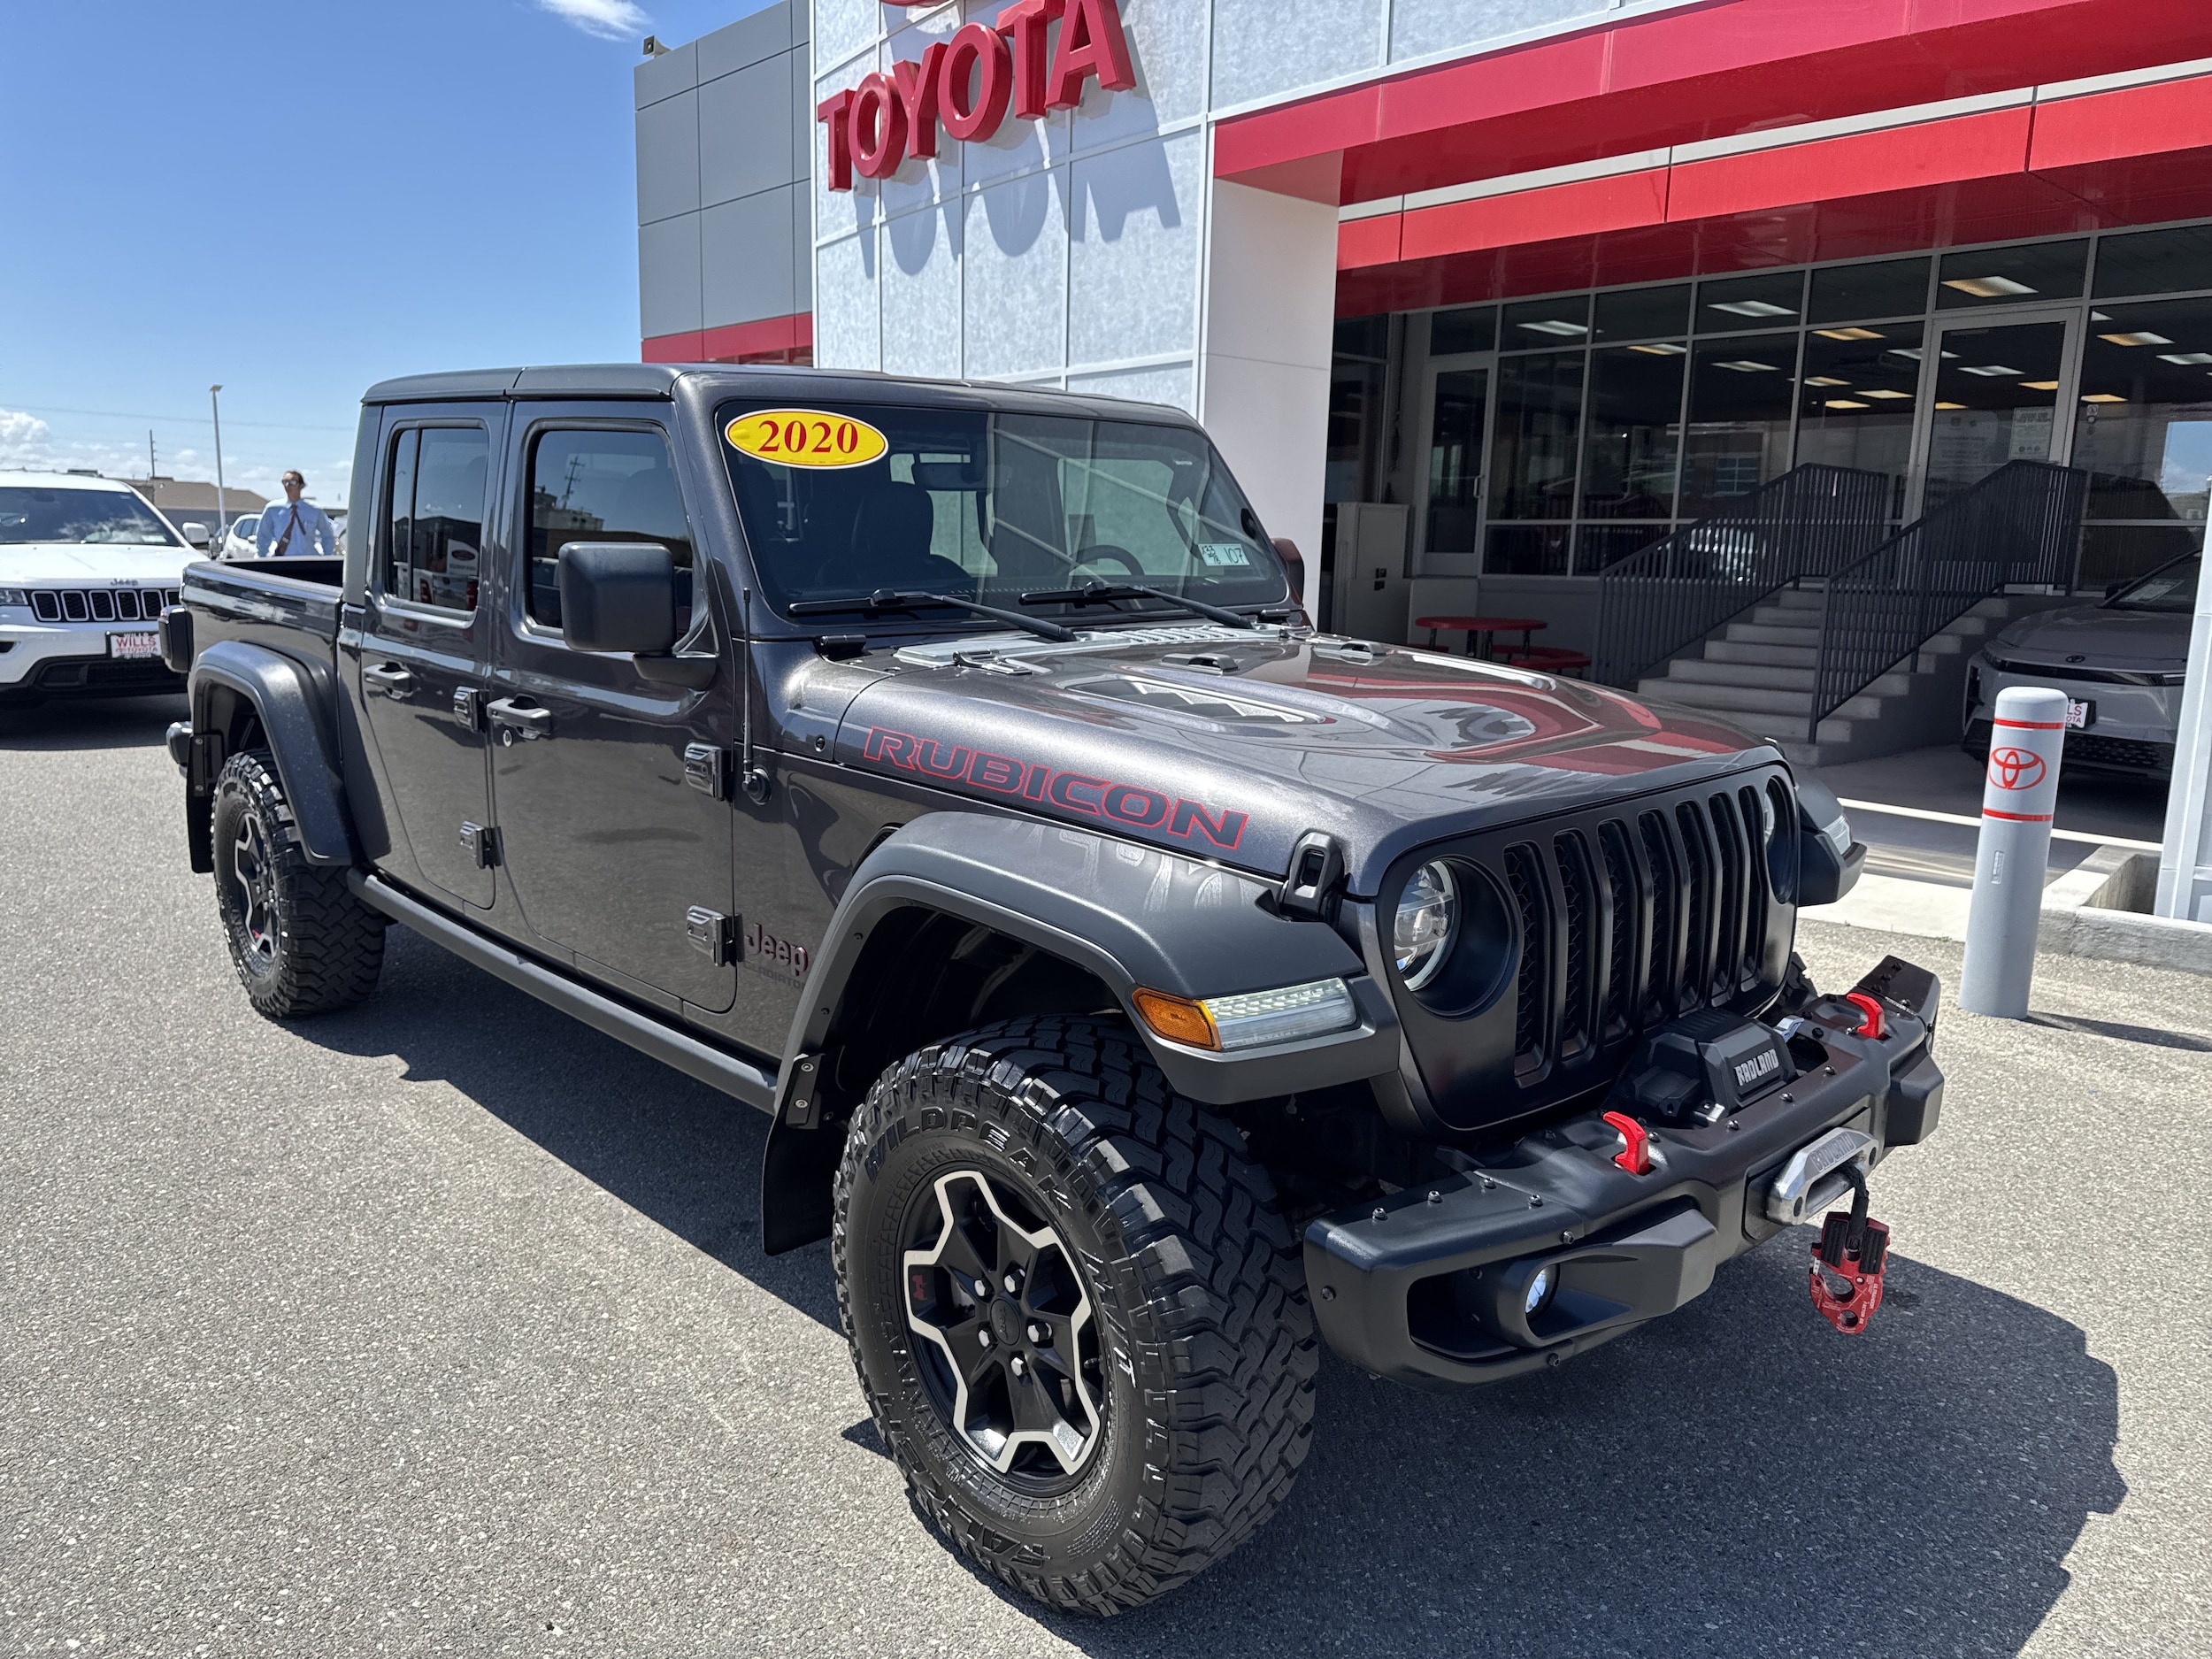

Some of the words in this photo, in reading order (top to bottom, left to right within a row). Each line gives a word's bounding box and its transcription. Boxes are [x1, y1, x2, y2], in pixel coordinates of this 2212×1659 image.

[818, 0, 1137, 192] TOYOTA
[757, 420, 858, 453] 2020
[111, 578, 138, 587] Jeep
[117, 636, 156, 647] WILLS
[864, 726, 1248, 850] RUBICON
[744, 923, 809, 976] Jeep
